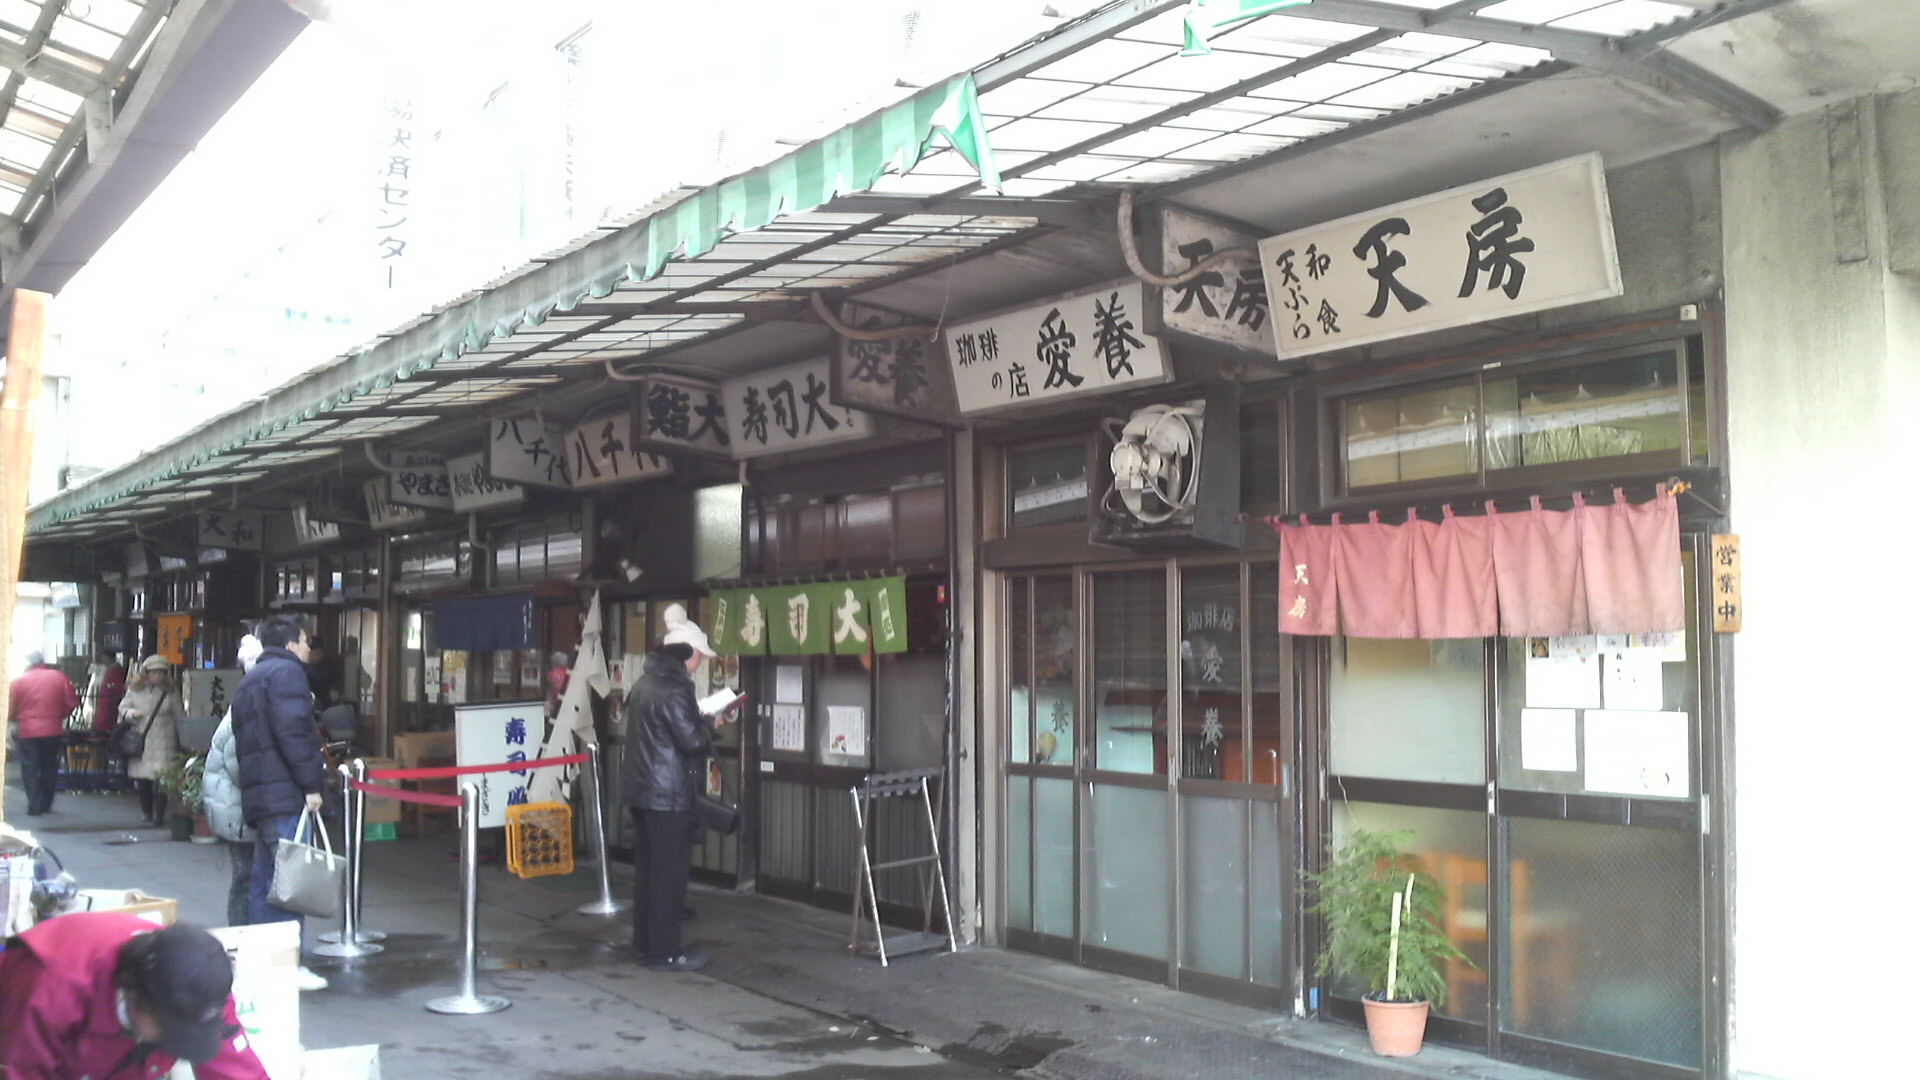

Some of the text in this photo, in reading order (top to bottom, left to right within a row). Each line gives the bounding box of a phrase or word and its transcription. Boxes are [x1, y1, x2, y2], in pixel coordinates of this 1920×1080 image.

[1173, 238, 1269, 332] 天房
[1276, 248, 1311, 340] 天ぷら
[1305, 243, 1341, 335] 和食
[1353, 188, 1535, 318] 天房
[1036, 290, 1145, 390] 愛養
[496, 419, 571, 486] 八千代
[742, 372, 840, 445] 寿司大
[1288, 563, 1309, 619] 天房
[1715, 544, 1737, 622] 営業中
